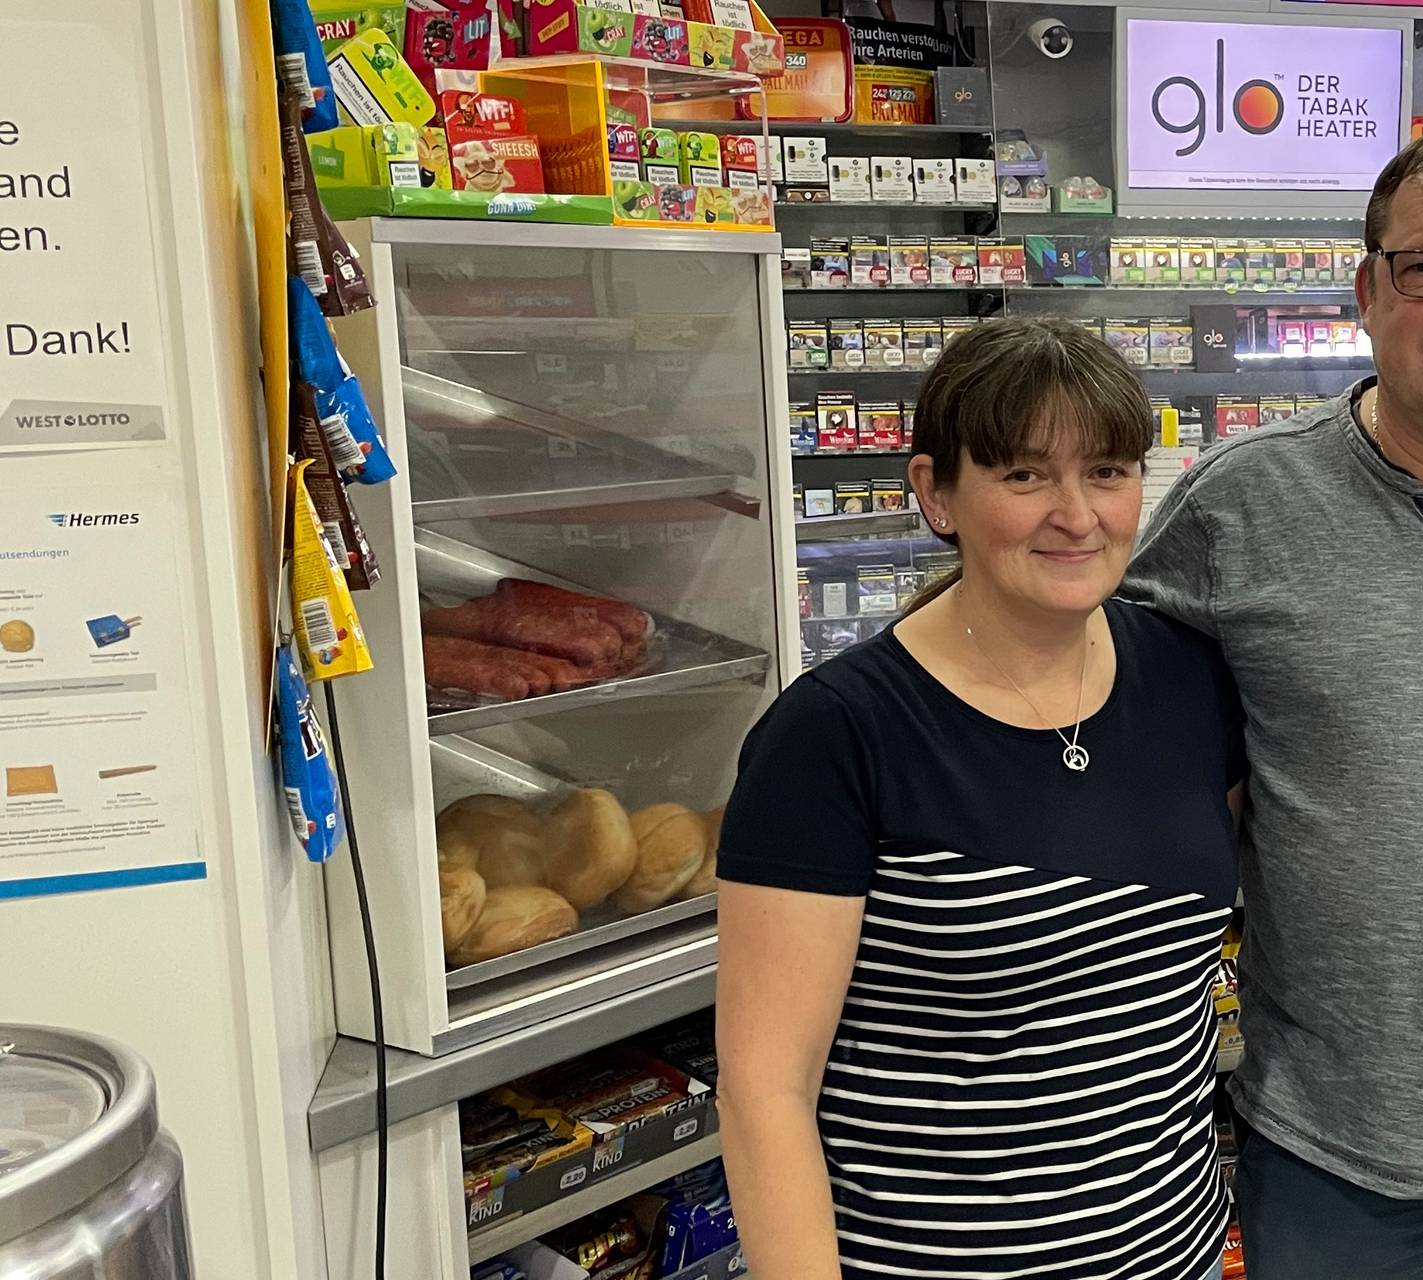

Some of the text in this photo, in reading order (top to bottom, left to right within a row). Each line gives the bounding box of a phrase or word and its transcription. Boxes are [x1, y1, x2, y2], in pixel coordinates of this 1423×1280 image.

[317, 19, 351, 40] CRAY
[468, 19, 485, 40] LIT
[721, 18, 747, 29] tödlich
[786, 31, 823, 46] EGA
[849, 26, 899, 43] Rauchen
[785, 55, 806, 67] 340
[853, 42, 923, 62] hre Arterien
[1297, 75, 1340, 93] DER
[1151, 38, 1285, 157] glo
[1297, 97, 1369, 116] TABAK
[476, 98, 514, 122] WTF!
[1297, 119, 1377, 138] HEATER
[491, 141, 538, 158] SHEEESH
[7, 322, 130, 356] Dank!
[1203, 328, 1224, 346] glo
[16, 413, 130, 428] WEST LOTTO
[69, 513, 140, 527] Hermes
[599, 1088, 670, 1118] PROTEIN
[592, 1149, 624, 1173] KIND
[468, 1201, 503, 1226] KIND
